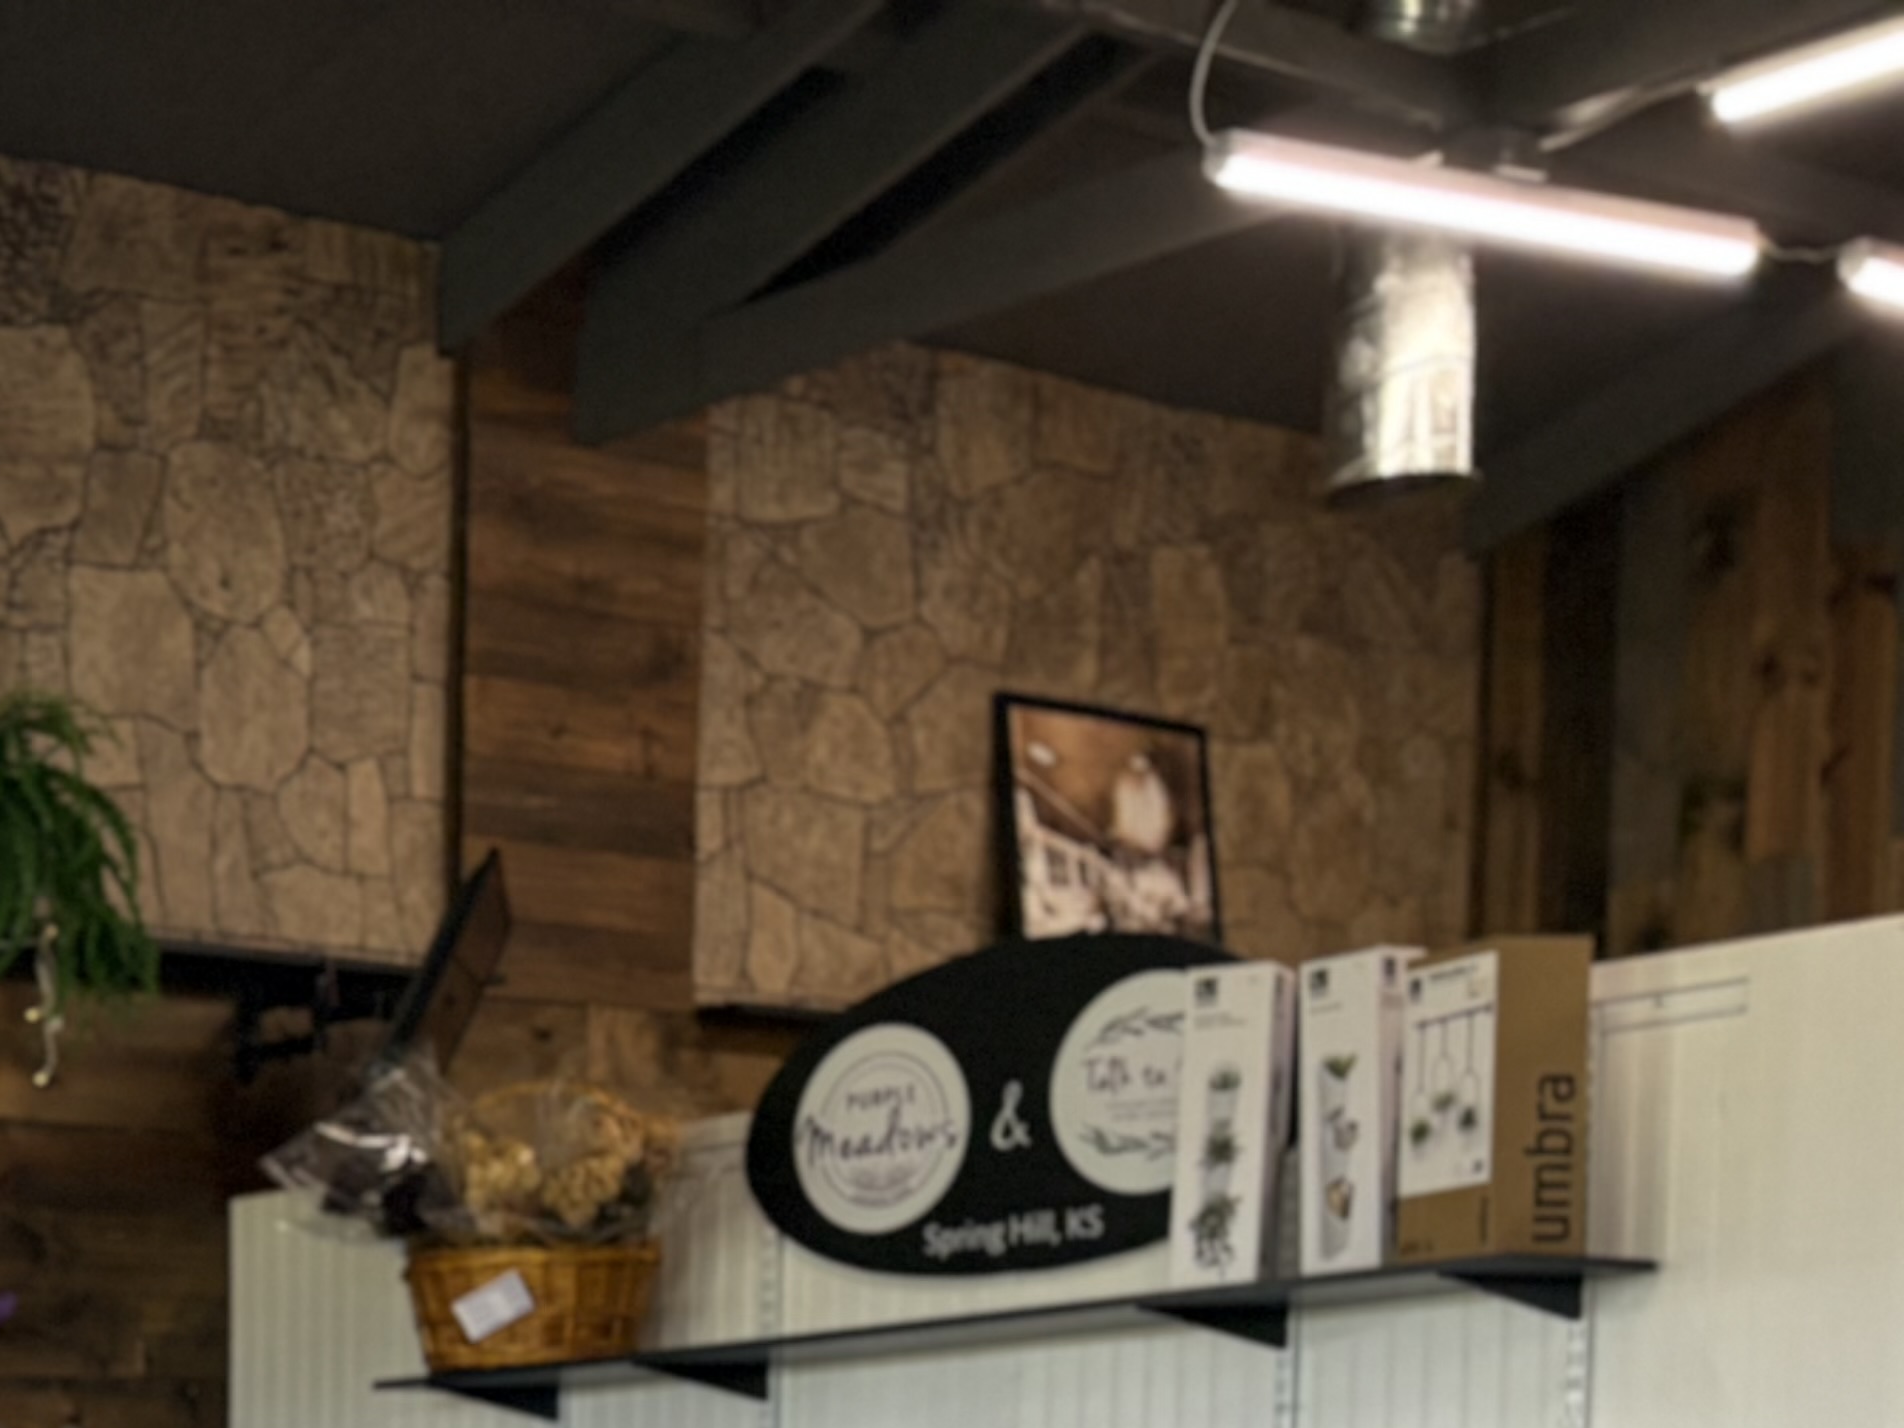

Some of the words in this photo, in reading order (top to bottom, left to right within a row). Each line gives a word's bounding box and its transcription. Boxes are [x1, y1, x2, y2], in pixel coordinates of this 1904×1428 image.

[794, 1105, 959, 1167] Meadows
[991, 1079, 1032, 1151] &
[1524, 1073, 1578, 1245] umbra
[922, 1220, 1007, 1262] Spring
[1008, 1210, 1062, 1247] Hill,
[1065, 1205, 1106, 1242] KS
